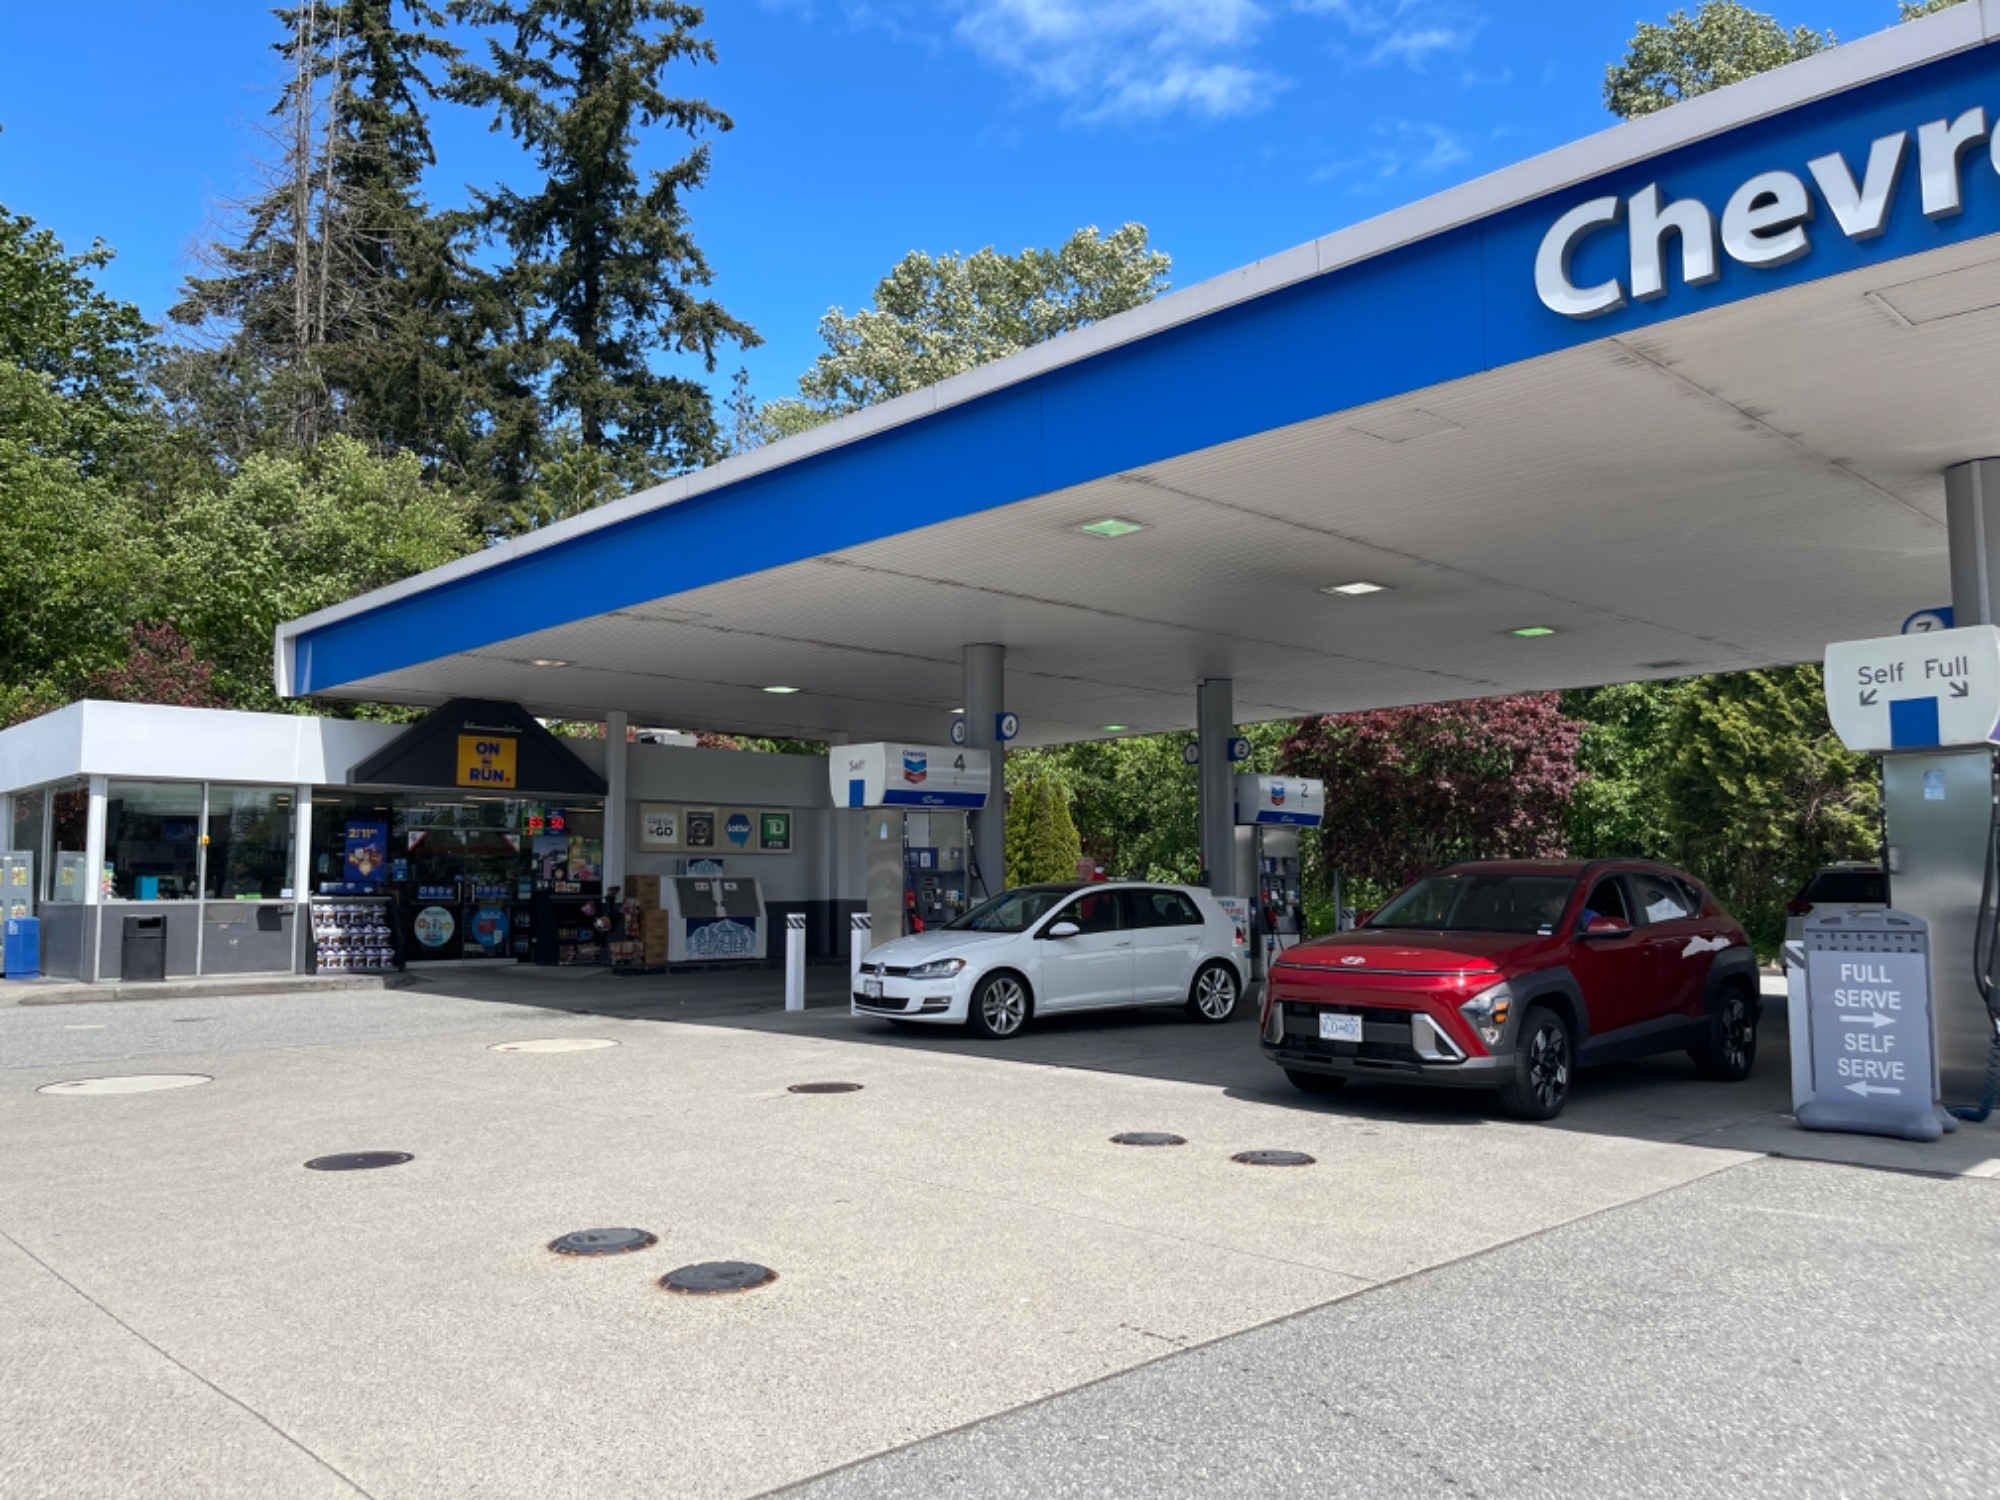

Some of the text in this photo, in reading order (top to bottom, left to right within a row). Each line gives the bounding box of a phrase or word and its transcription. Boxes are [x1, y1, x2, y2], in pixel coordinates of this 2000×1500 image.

[1534, 106, 2000, 319] Chevr
[1858, 656, 1969, 685] Self Full
[956, 727, 963, 742] 3
[1005, 719, 1014, 734] 4
[476, 742, 500, 754] ON
[1237, 743, 1245, 755] 2
[954, 754, 966, 772] 4
[1301, 784, 1308, 798] 2
[656, 827, 673, 836] GO
[767, 819, 785, 834] TD
[1841, 964, 1892, 983] FULL
[1834, 988, 1902, 1010] SERVE
[1844, 1032, 1895, 1053] SELF
[1837, 1057, 1905, 1080] SERVE
